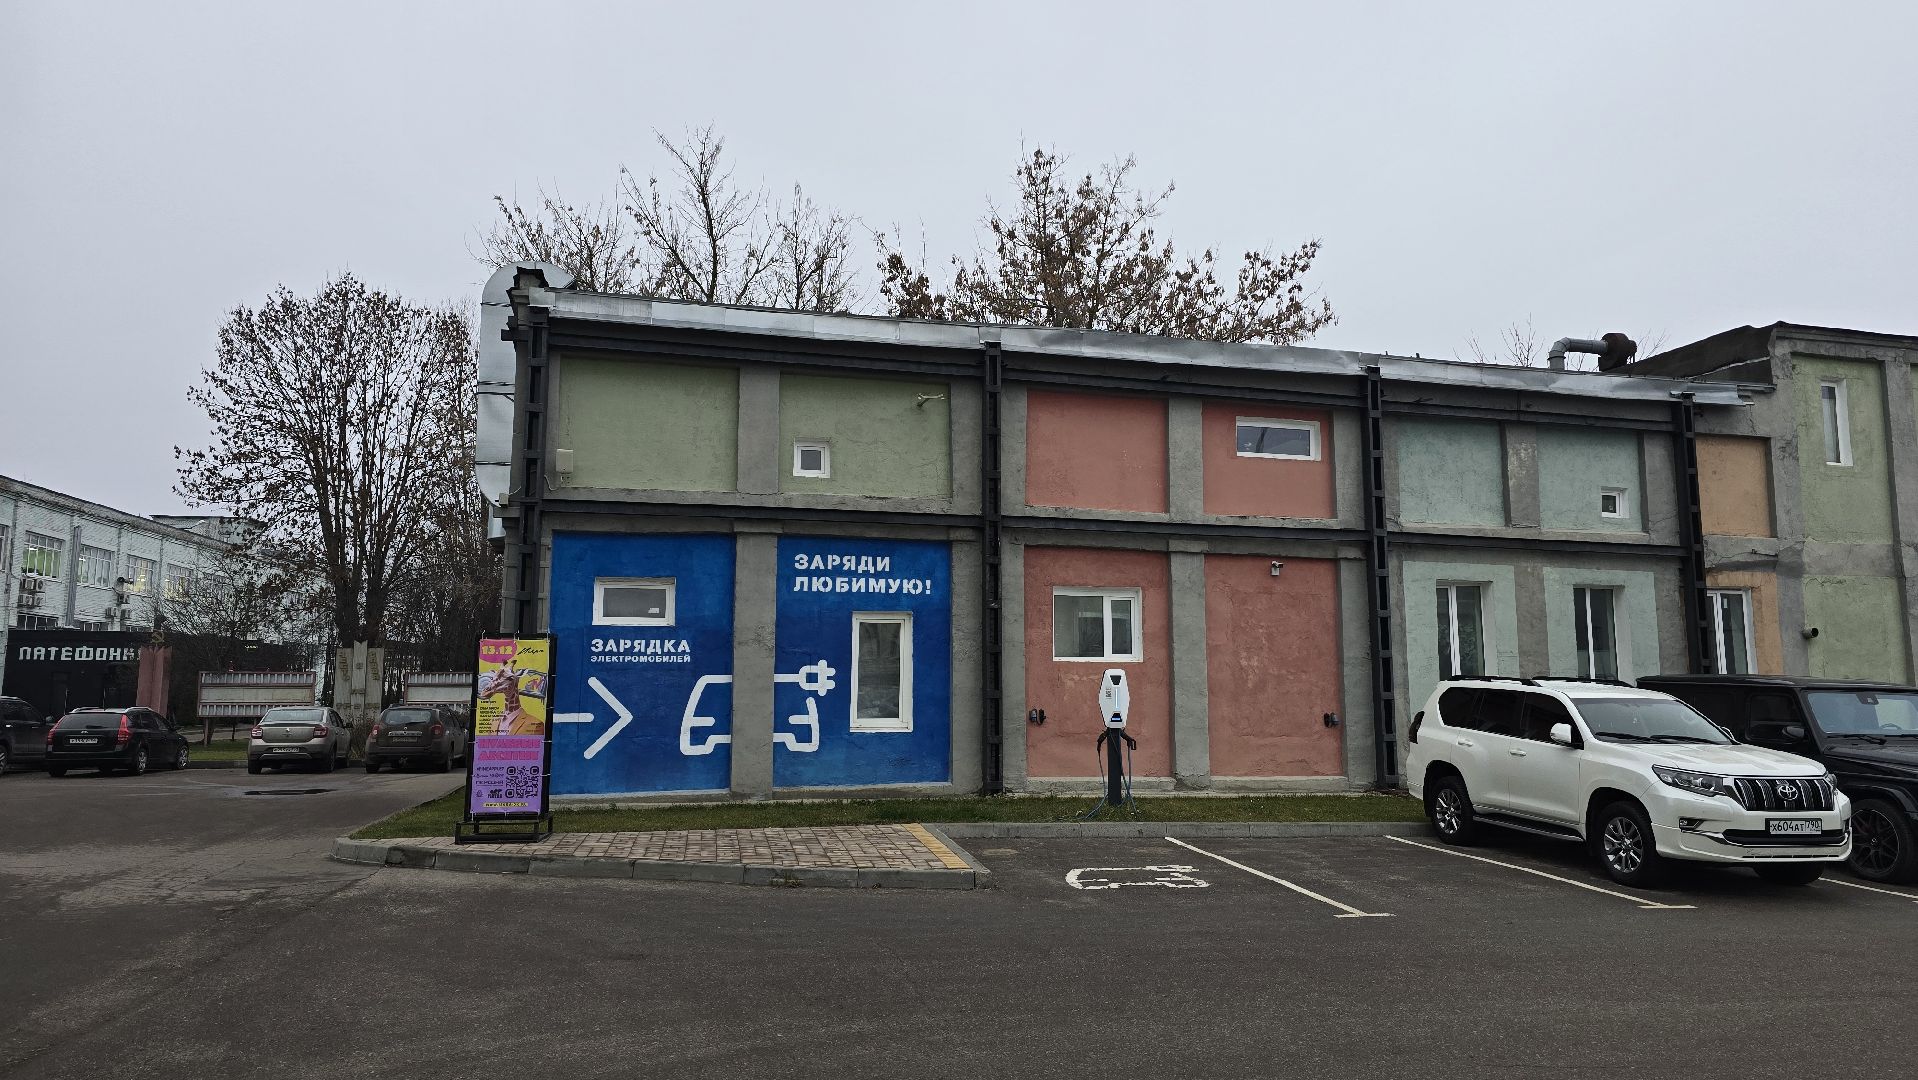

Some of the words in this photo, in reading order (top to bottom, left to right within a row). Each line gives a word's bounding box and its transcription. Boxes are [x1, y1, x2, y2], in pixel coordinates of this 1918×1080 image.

[794, 553, 890, 574] ЗАРЯДИ
[793, 577, 931, 595] ЛЮБИМУЮ!
[482, 646, 512, 655] 13.12
[590, 638, 691, 655] ЗАРЯДКА
[590, 654, 691, 663] ЭЛЕКТРОМОБИЛЕЙ
